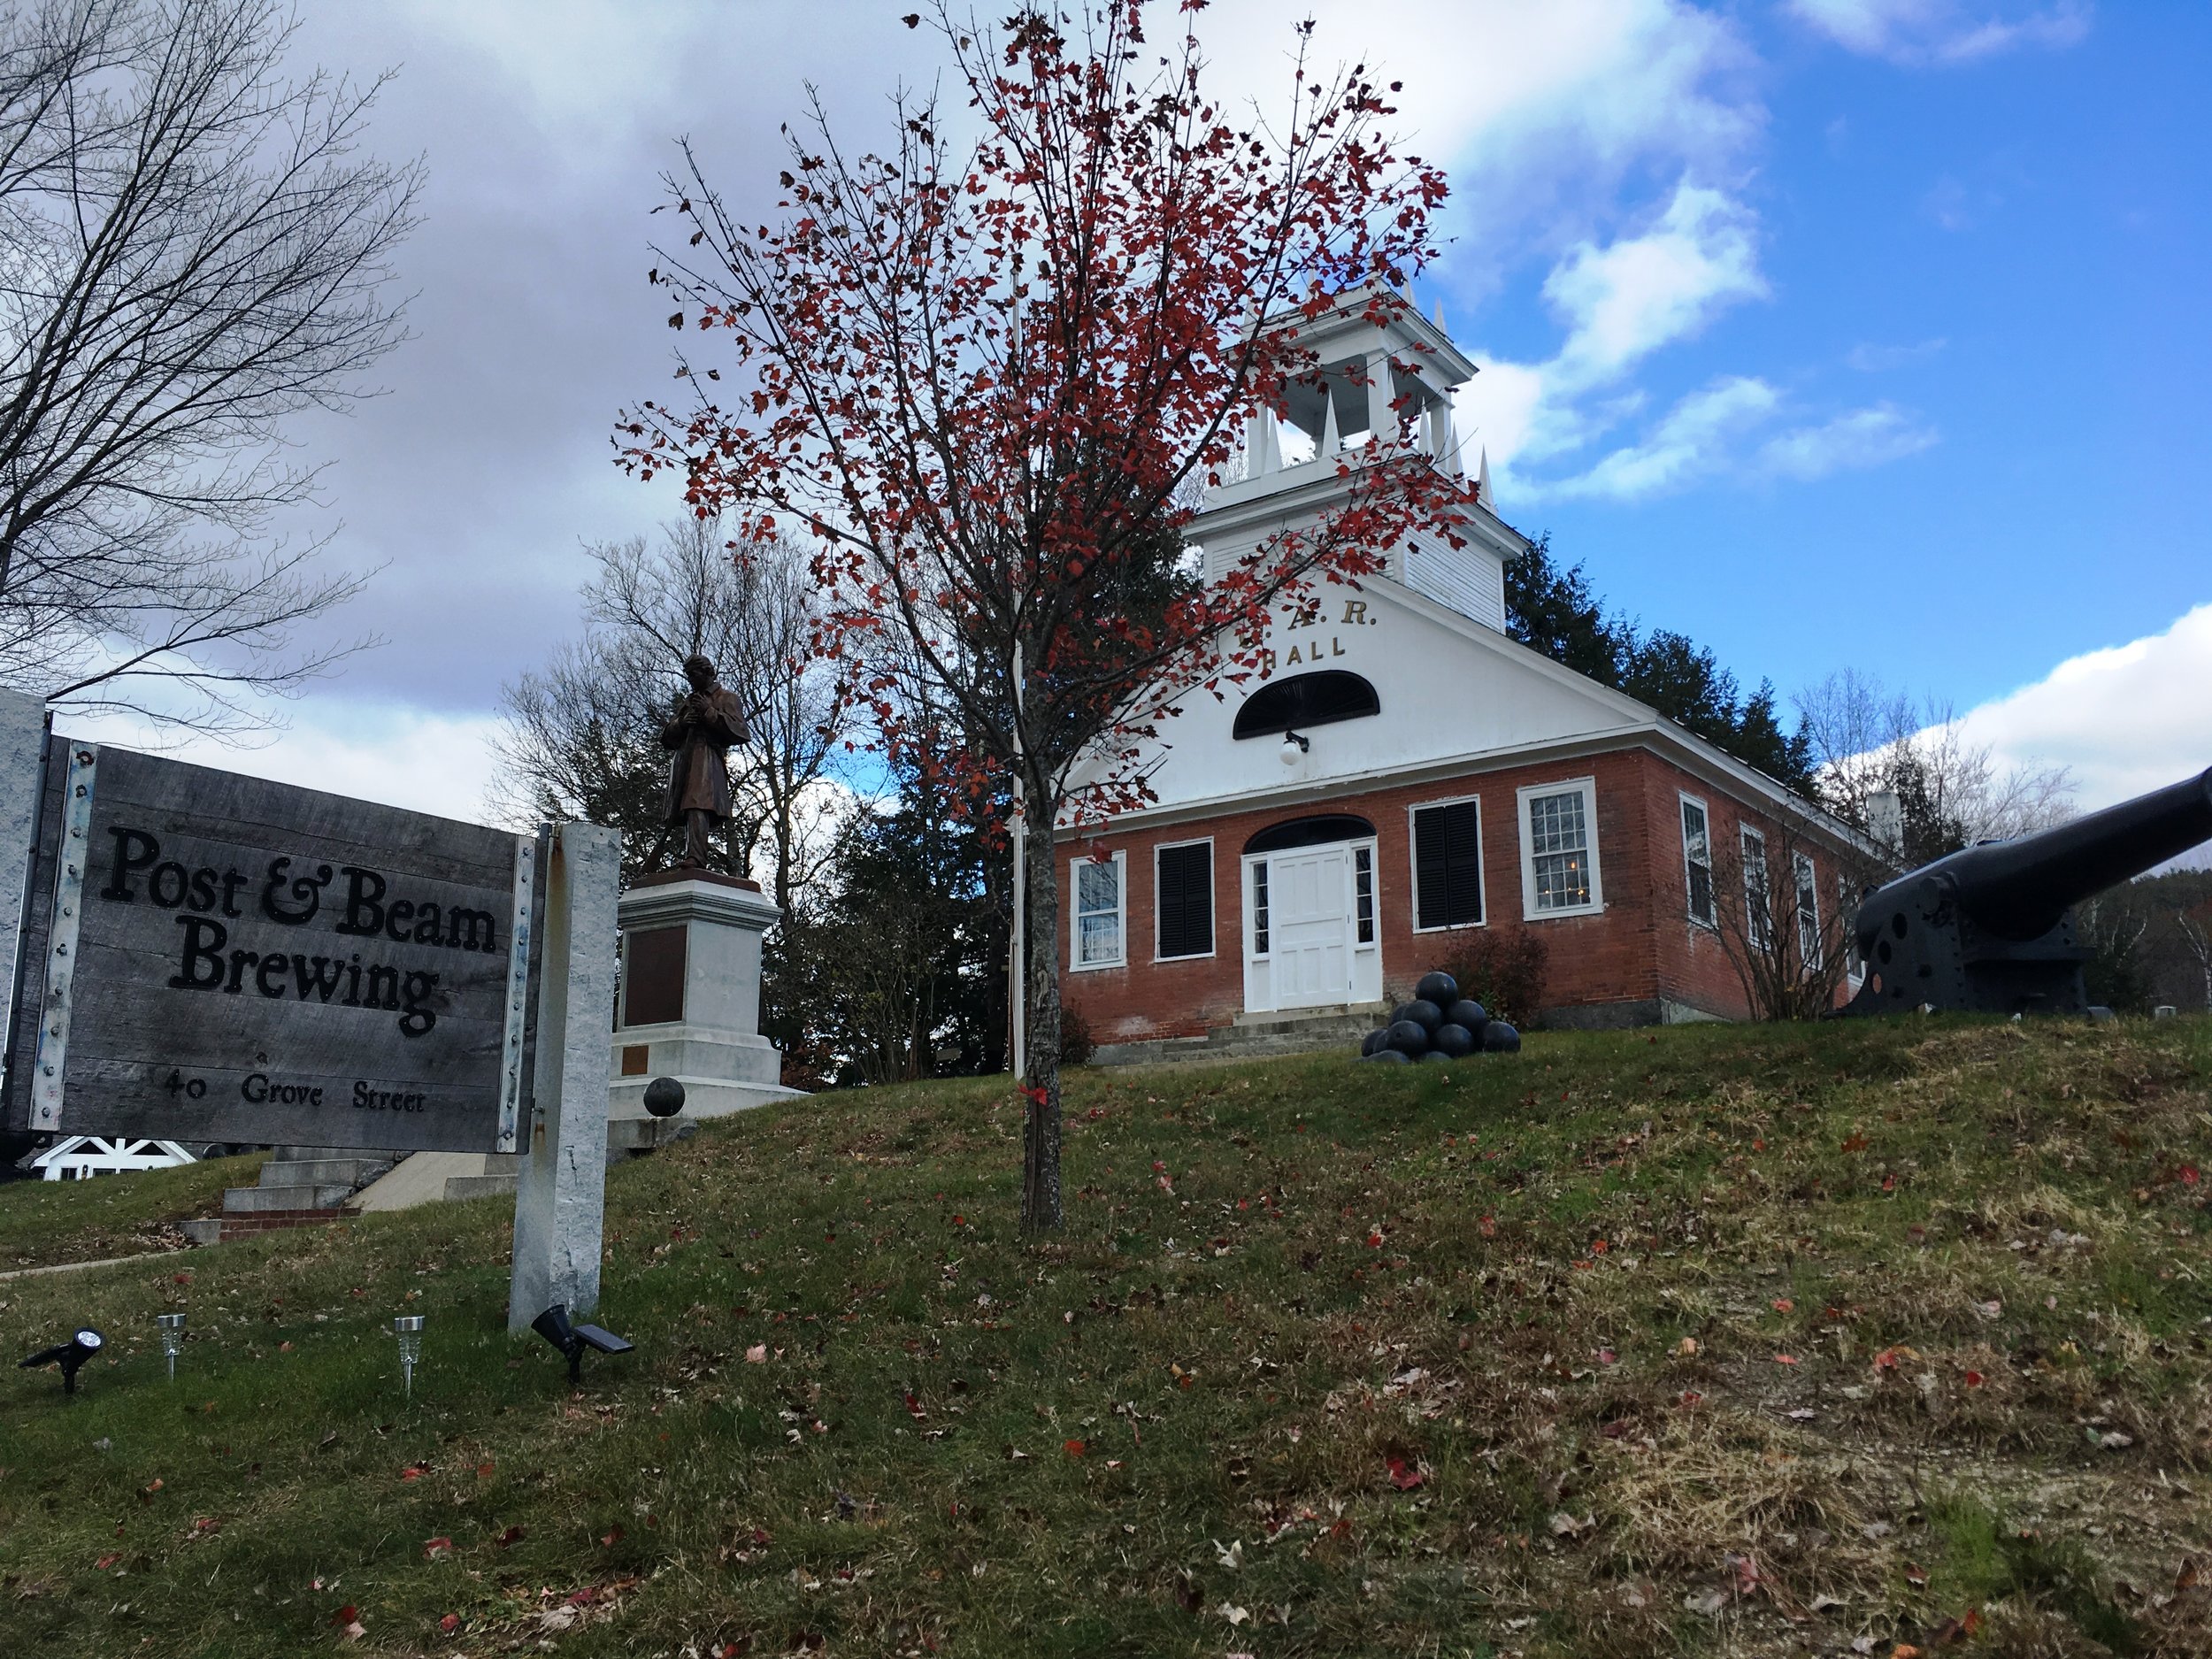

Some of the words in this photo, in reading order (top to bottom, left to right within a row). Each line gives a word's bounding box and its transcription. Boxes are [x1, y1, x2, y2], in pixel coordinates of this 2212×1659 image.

[1340, 600, 1377, 626] R.
[1263, 637, 1346, 670] HALL
[100, 826, 248, 918] Post
[262, 856, 333, 925] &
[335, 866, 497, 953] Beam
[169, 915, 441, 1038] Brewing
[242, 1073, 323, 1106] Grove
[352, 1080, 426, 1113] Street
